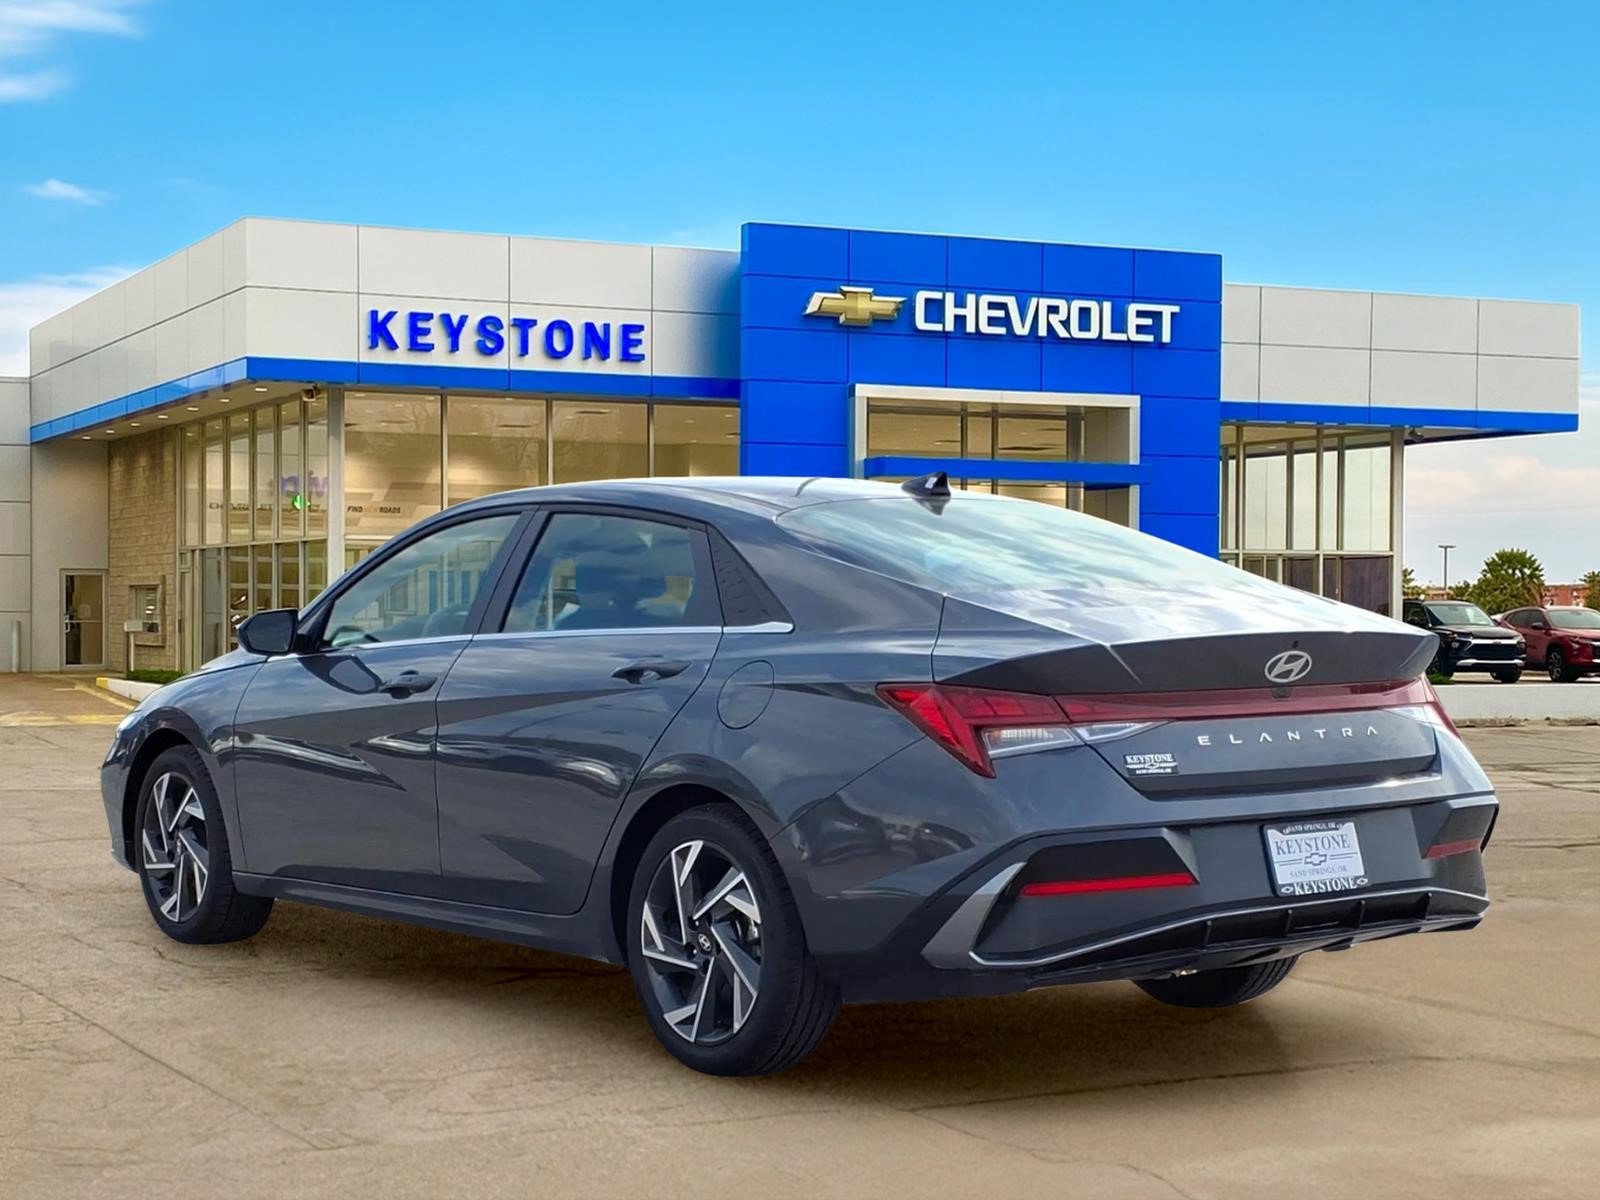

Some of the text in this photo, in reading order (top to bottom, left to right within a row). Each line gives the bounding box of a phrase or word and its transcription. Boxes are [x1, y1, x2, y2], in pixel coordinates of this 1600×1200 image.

[915, 290, 1181, 344] CHEVROLET
[367, 309, 646, 363] KEYSTONE
[1197, 726, 1379, 746] ELANTRA
[1125, 753, 1174, 764] KEYSTONE
[1275, 833, 1351, 856] KEYSTONE
[1293, 877, 1357, 896] KEYSTONE
